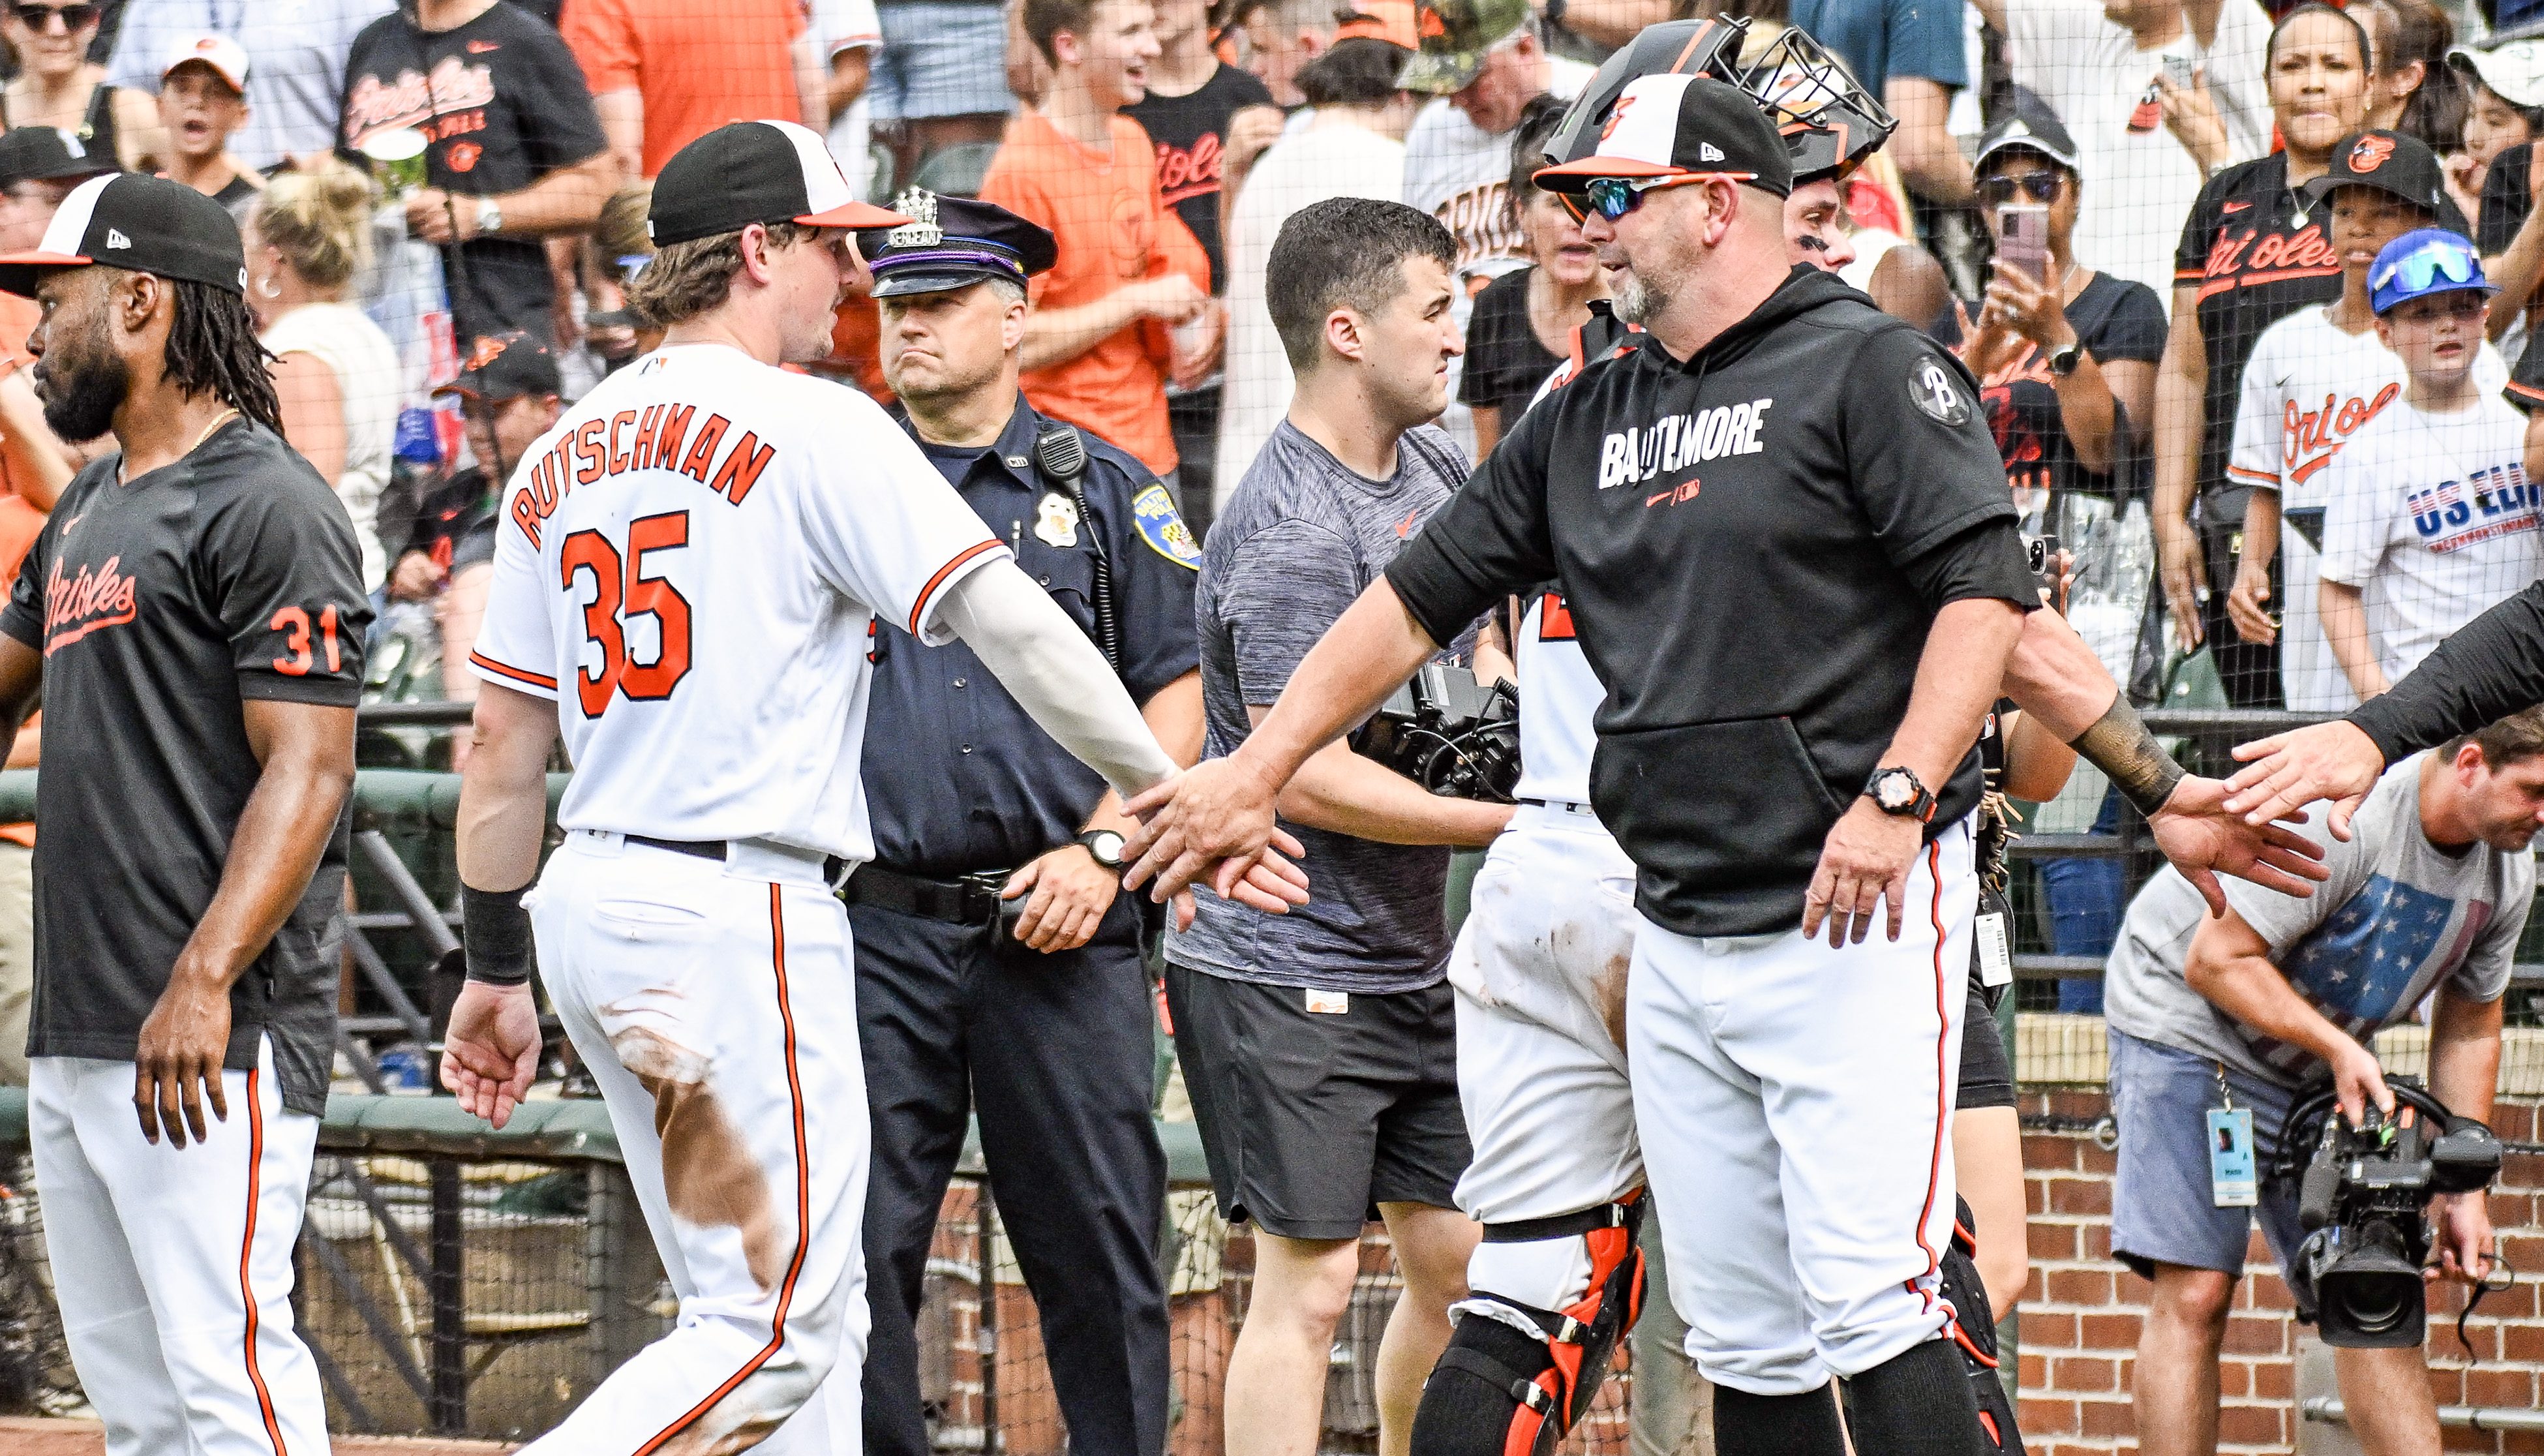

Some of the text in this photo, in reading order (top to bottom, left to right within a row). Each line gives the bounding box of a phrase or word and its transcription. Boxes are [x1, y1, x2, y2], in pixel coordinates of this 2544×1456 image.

[511, 402, 776, 553] RUTSCHMAN
[2408, 480, 2471, 538] US
[44, 555, 137, 643] Orioles
[270, 604, 341, 676] 31
[560, 509, 693, 720] 35
